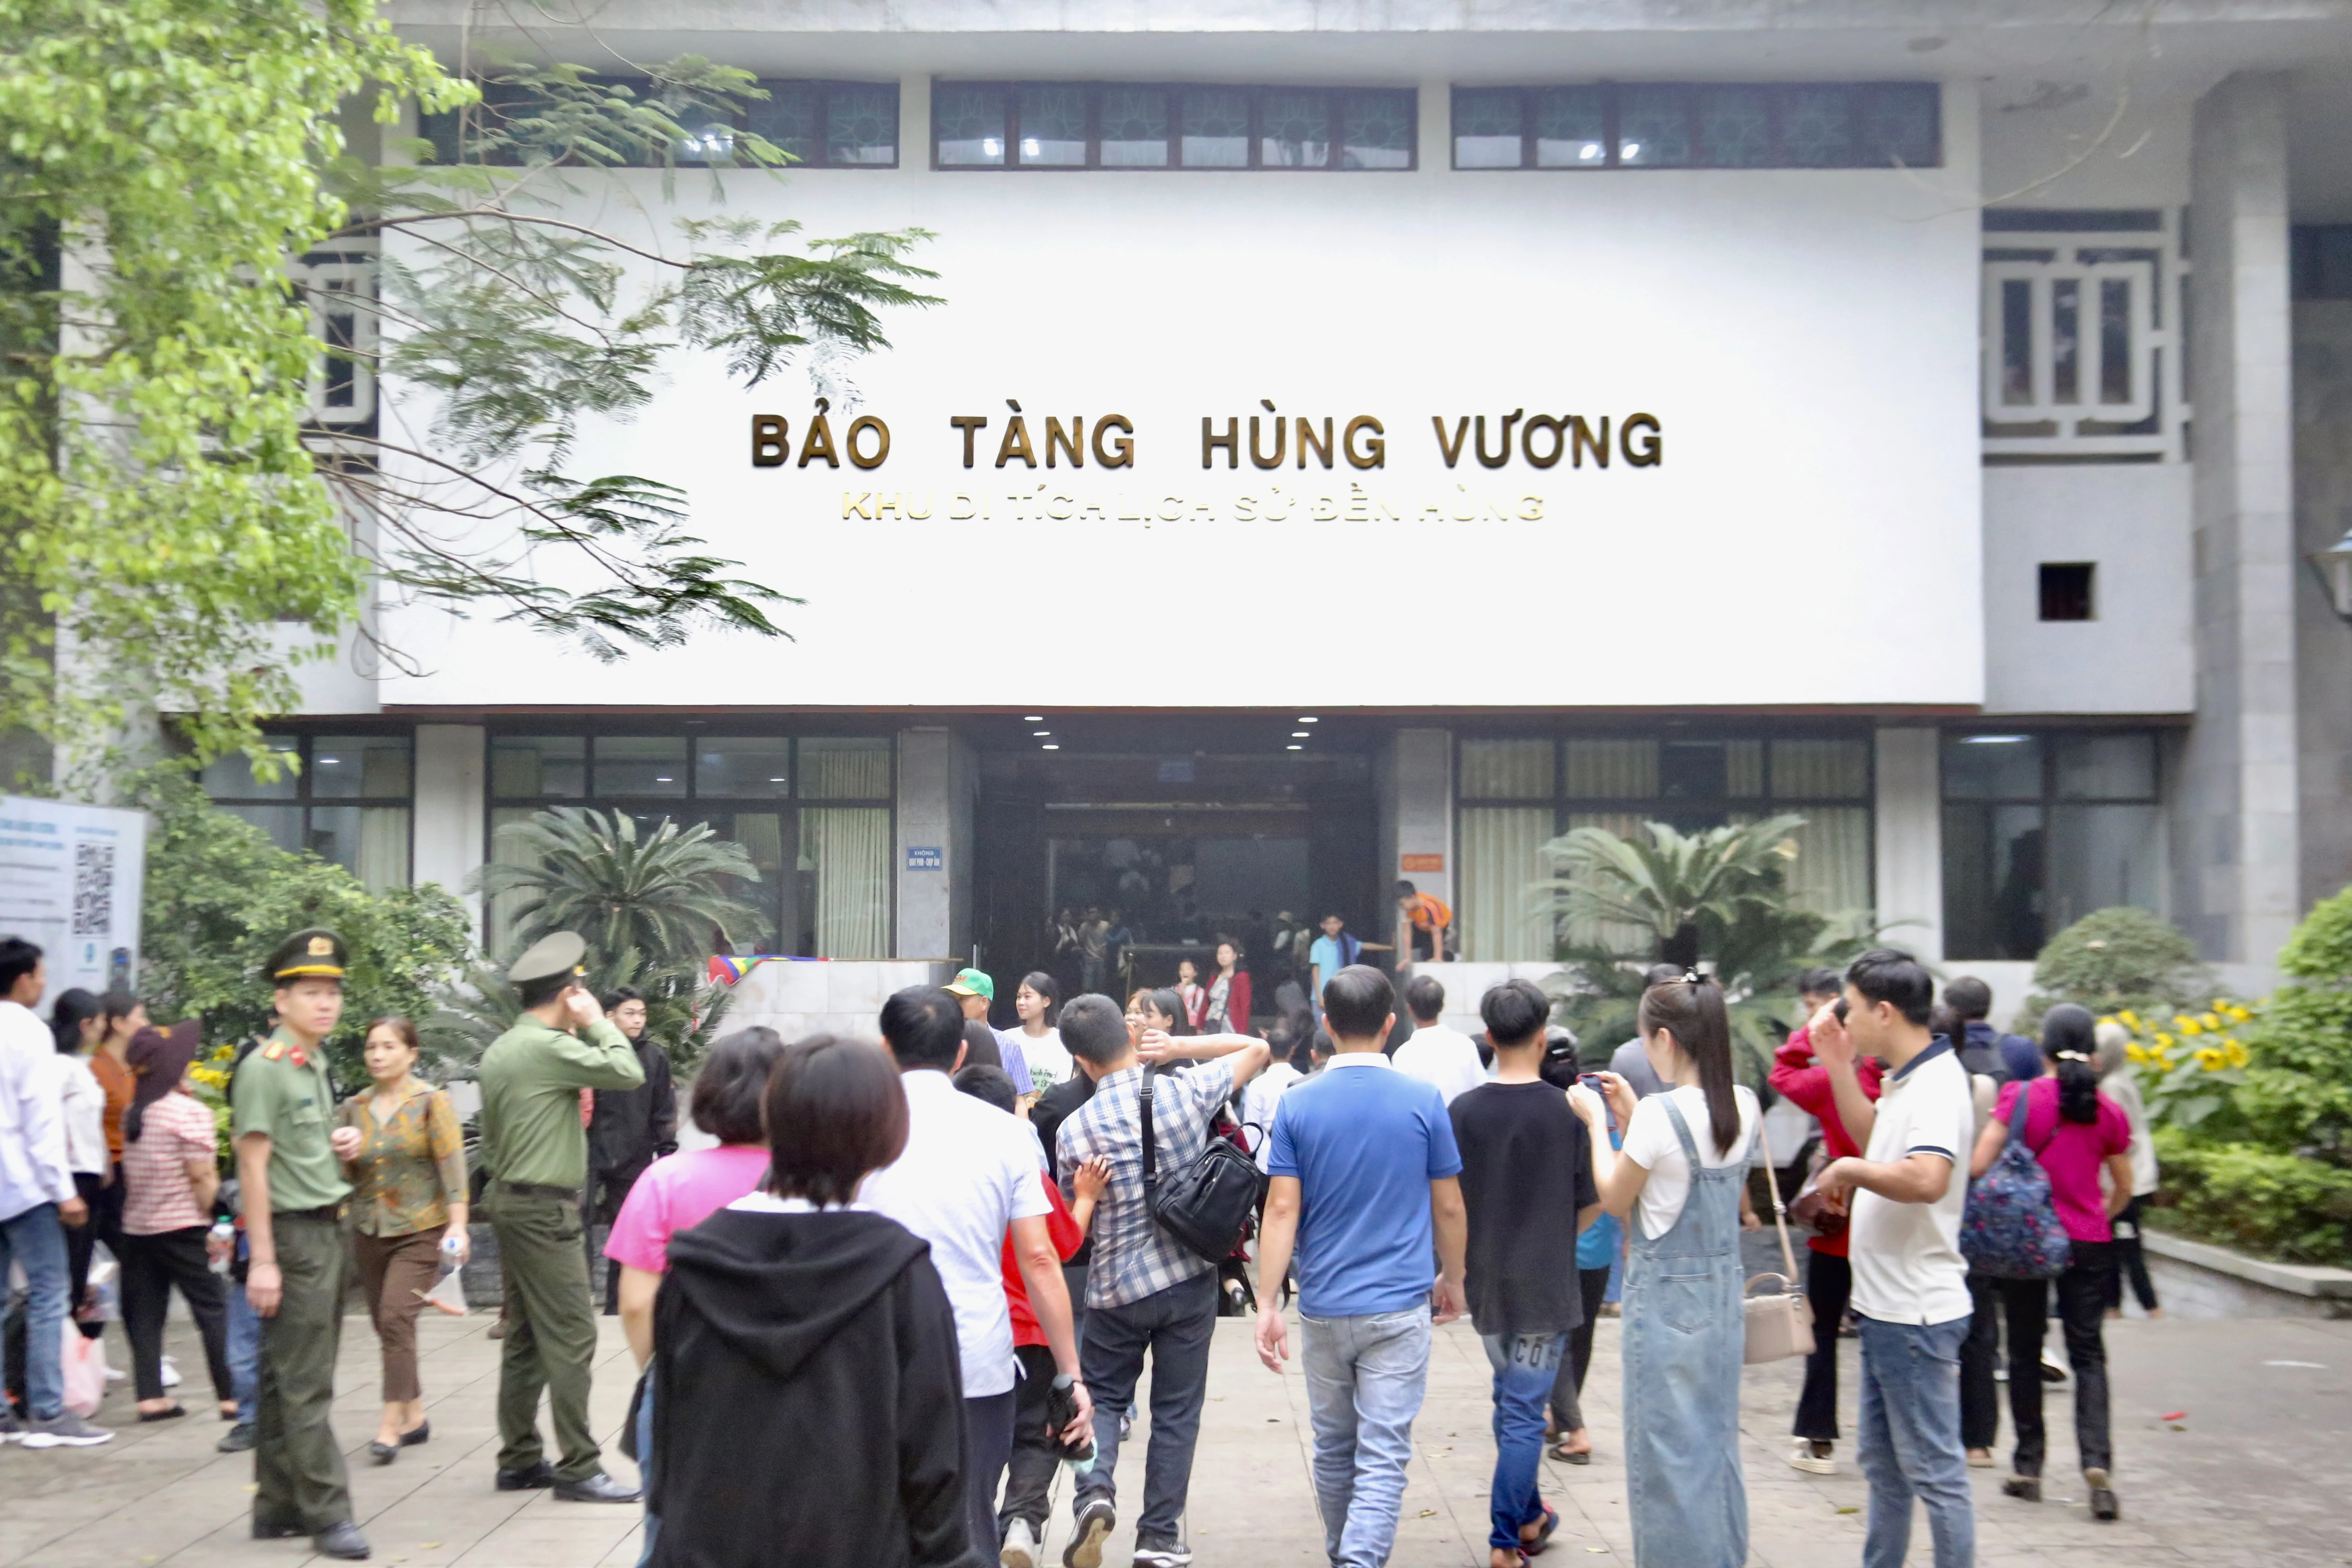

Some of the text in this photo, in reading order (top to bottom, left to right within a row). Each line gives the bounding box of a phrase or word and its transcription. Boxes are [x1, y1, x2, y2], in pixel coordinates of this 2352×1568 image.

[752, 397, 1661, 470] BẢO TÀNG HÙNG VƯƠNG
[842, 482, 1545, 529] KHU DI TÍCH LỊCH SỬ ĐỀN HÙNG
